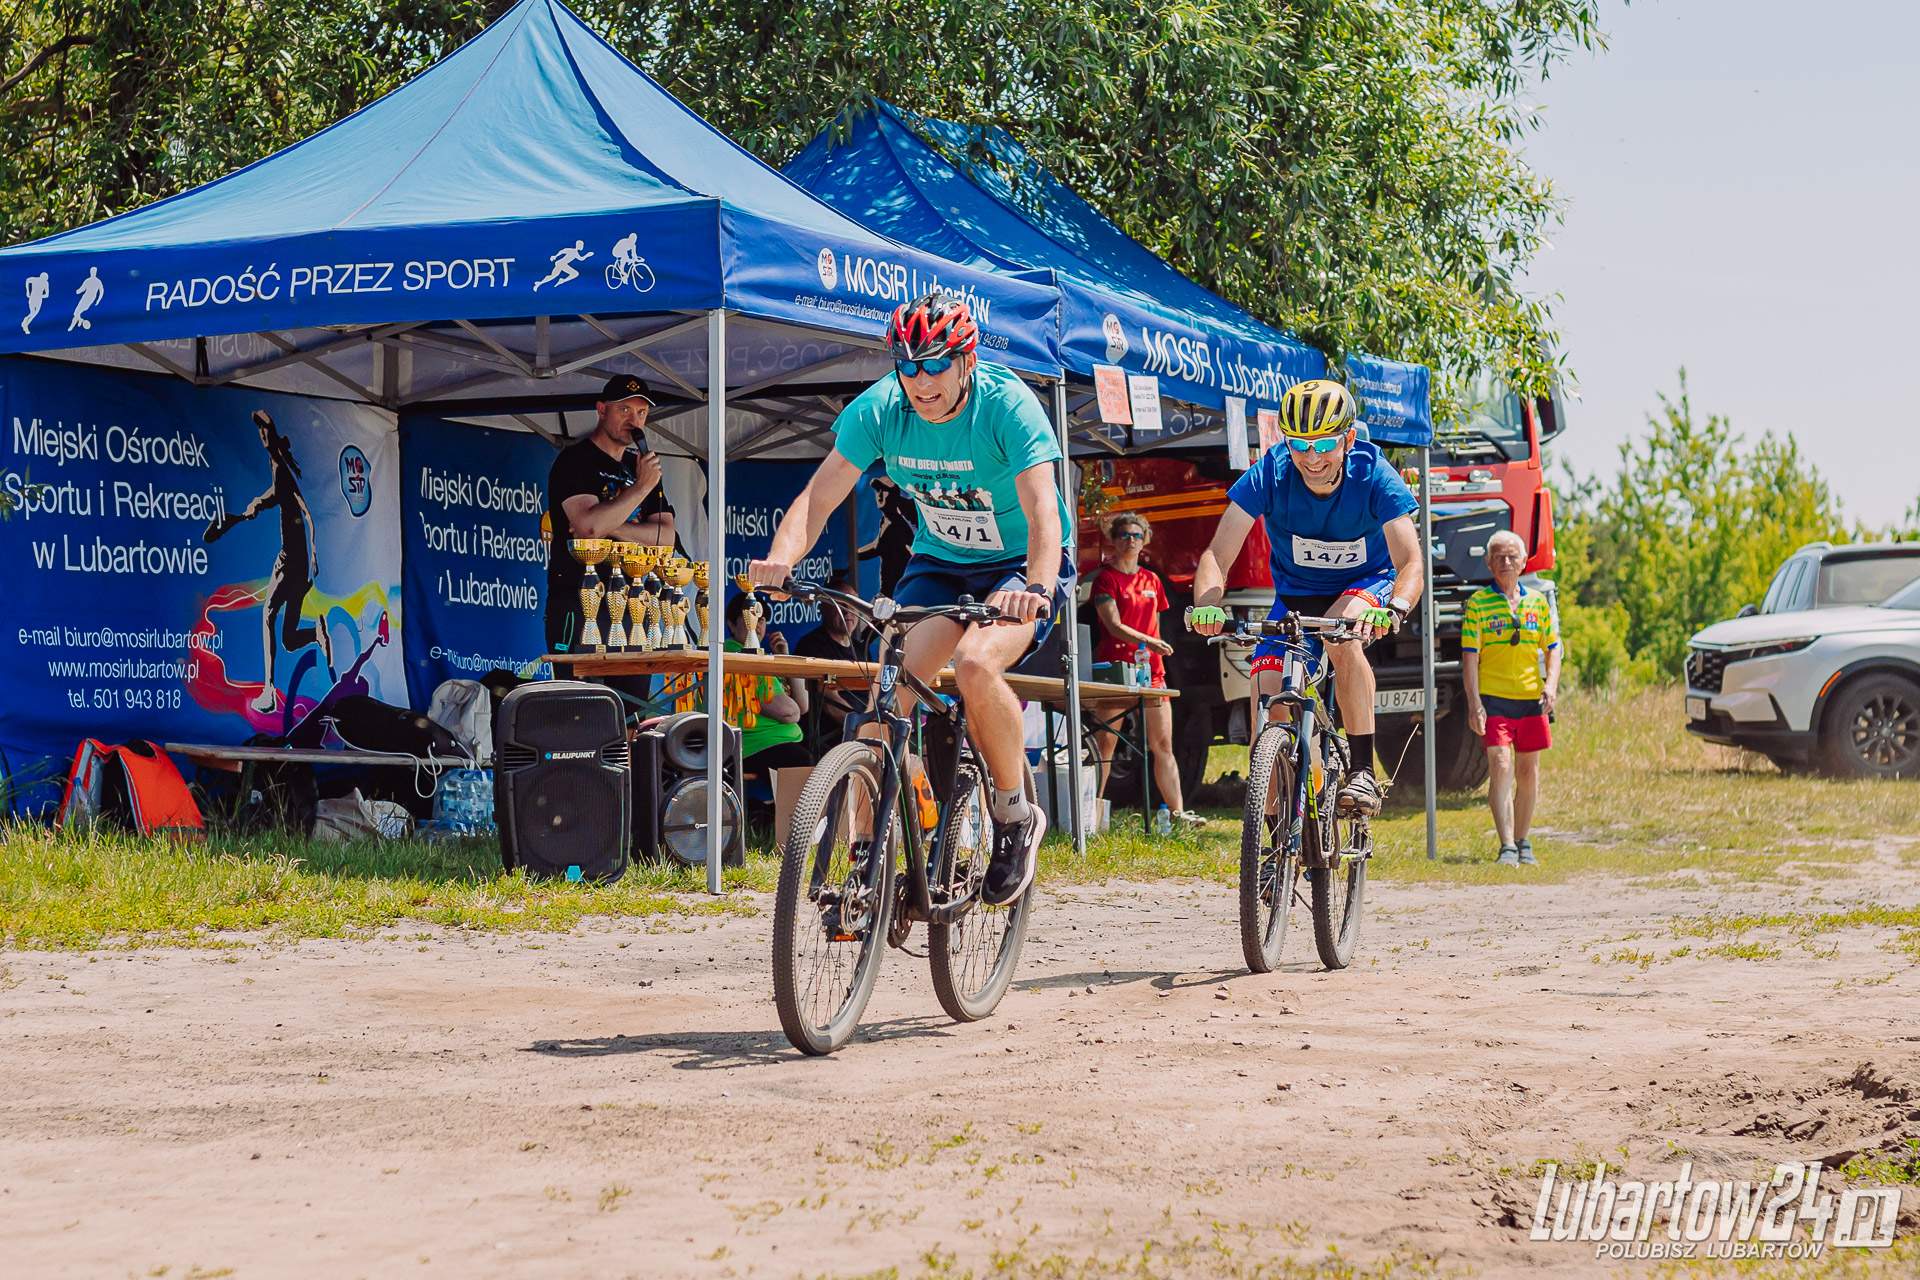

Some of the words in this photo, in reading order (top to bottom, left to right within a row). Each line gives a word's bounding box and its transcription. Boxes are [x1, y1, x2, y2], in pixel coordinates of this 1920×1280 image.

[146, 263, 282, 311] RADOŚĆ
[289, 261, 394, 296] PRZEZ
[403, 257, 516, 290] SPORT
[844, 254, 909, 303] MOSiR
[996, 336, 1010, 350] 818
[1142, 326, 1215, 387] MOSiR
[12, 416, 98, 467] Miejski
[105, 426, 210, 468] Ośrodek
[5, 472, 92, 521] Sportu
[100, 480, 105, 517] i
[114, 481, 227, 530] Rekreacji
[932, 520, 993, 543] 14/1
[32, 541, 56, 570] w
[63, 534, 209, 575] Lubartowie
[1303, 550, 1359, 565] 14/2
[446, 569, 538, 610] Lubartowie
[18, 627, 61, 647] e-mail
[64, 627, 224, 654] biuro@mosirlubartow.pl
[48, 659, 200, 684] www.mosirlubartow.pl
[67, 689, 90, 709] tel.
[93, 689, 122, 710] 501
[125, 690, 153, 710] 943
[156, 690, 182, 710] 818
[1393, 690, 1425, 707] 874T
[552, 751, 596, 760] BLAUPUNKT
